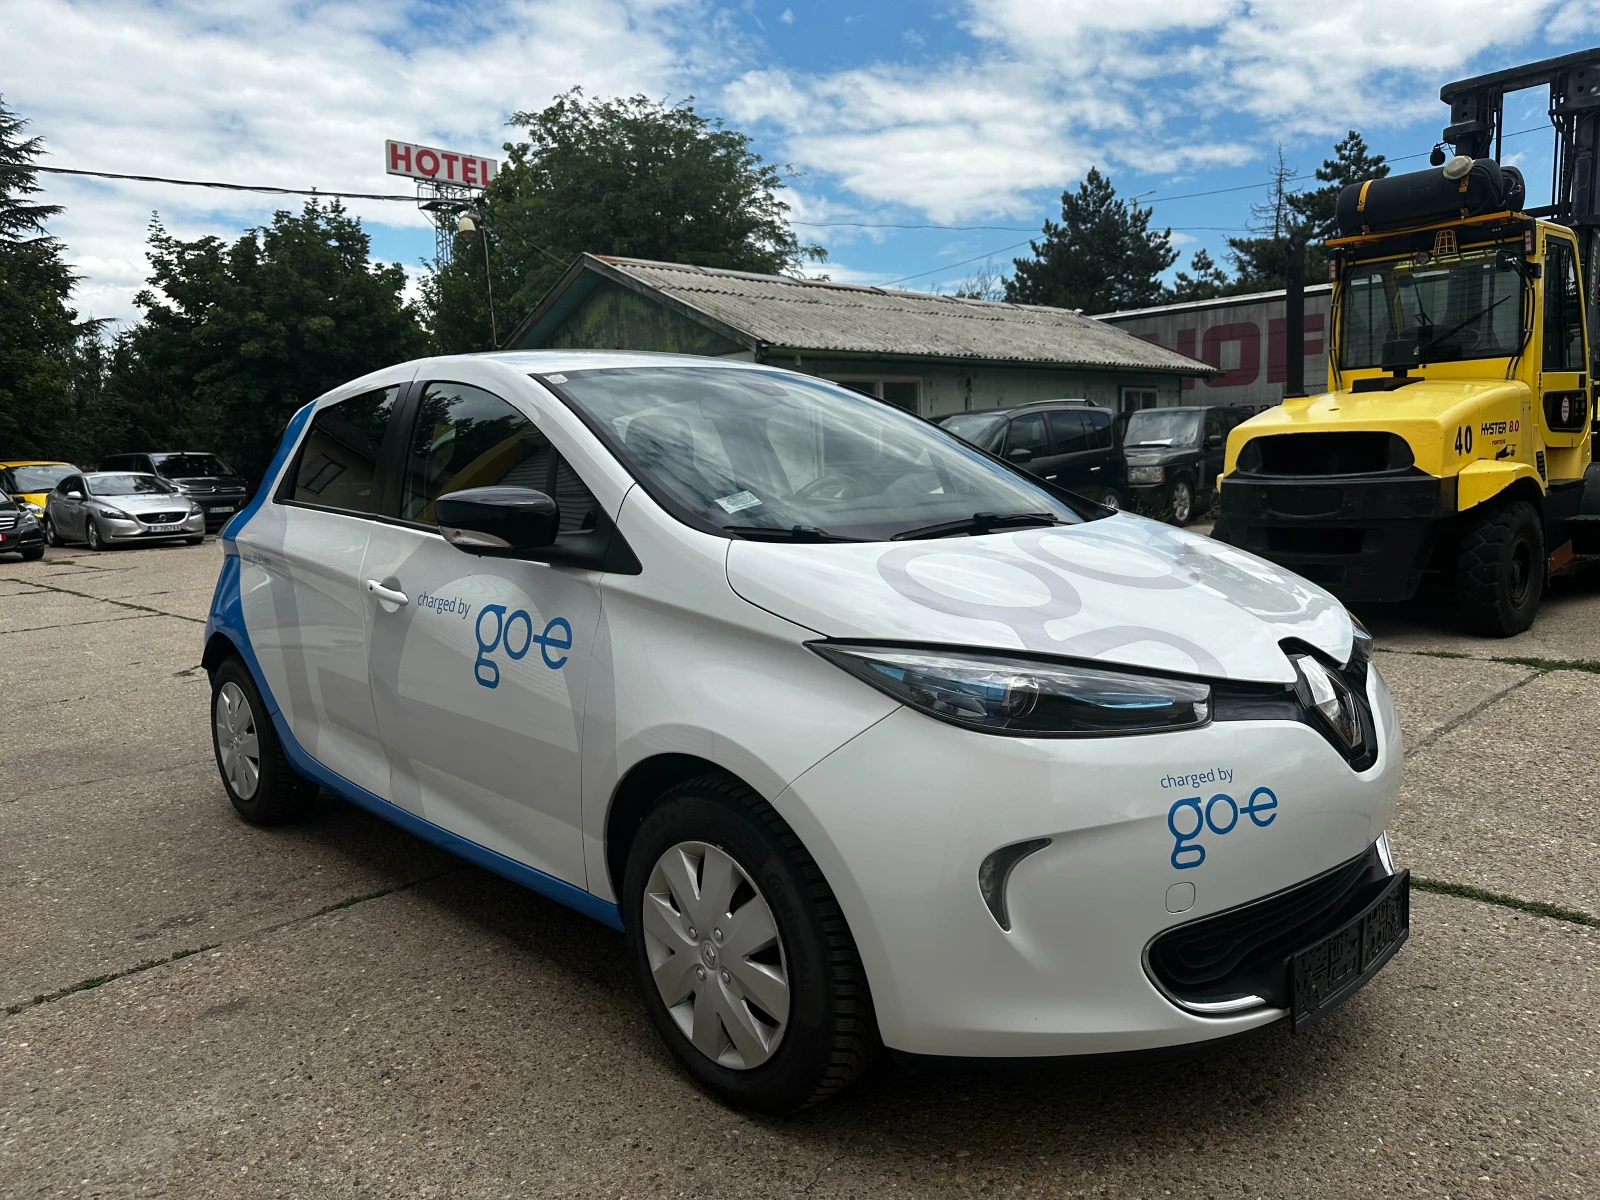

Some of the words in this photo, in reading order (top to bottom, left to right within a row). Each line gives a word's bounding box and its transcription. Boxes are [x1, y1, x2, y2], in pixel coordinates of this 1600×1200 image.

[390, 143, 493, 186] HOTEL
[1454, 424, 1473, 456] 40
[1480, 421, 1507, 436] HYSTER
[1508, 420, 1520, 433] 8.0
[417, 591, 457, 615] charged
[457, 598, 472, 620] by
[474, 603, 573, 690] go-e
[1160, 768, 1216, 789] charged
[1217, 767, 1233, 784] by
[1167, 786, 1278, 870] go-e
